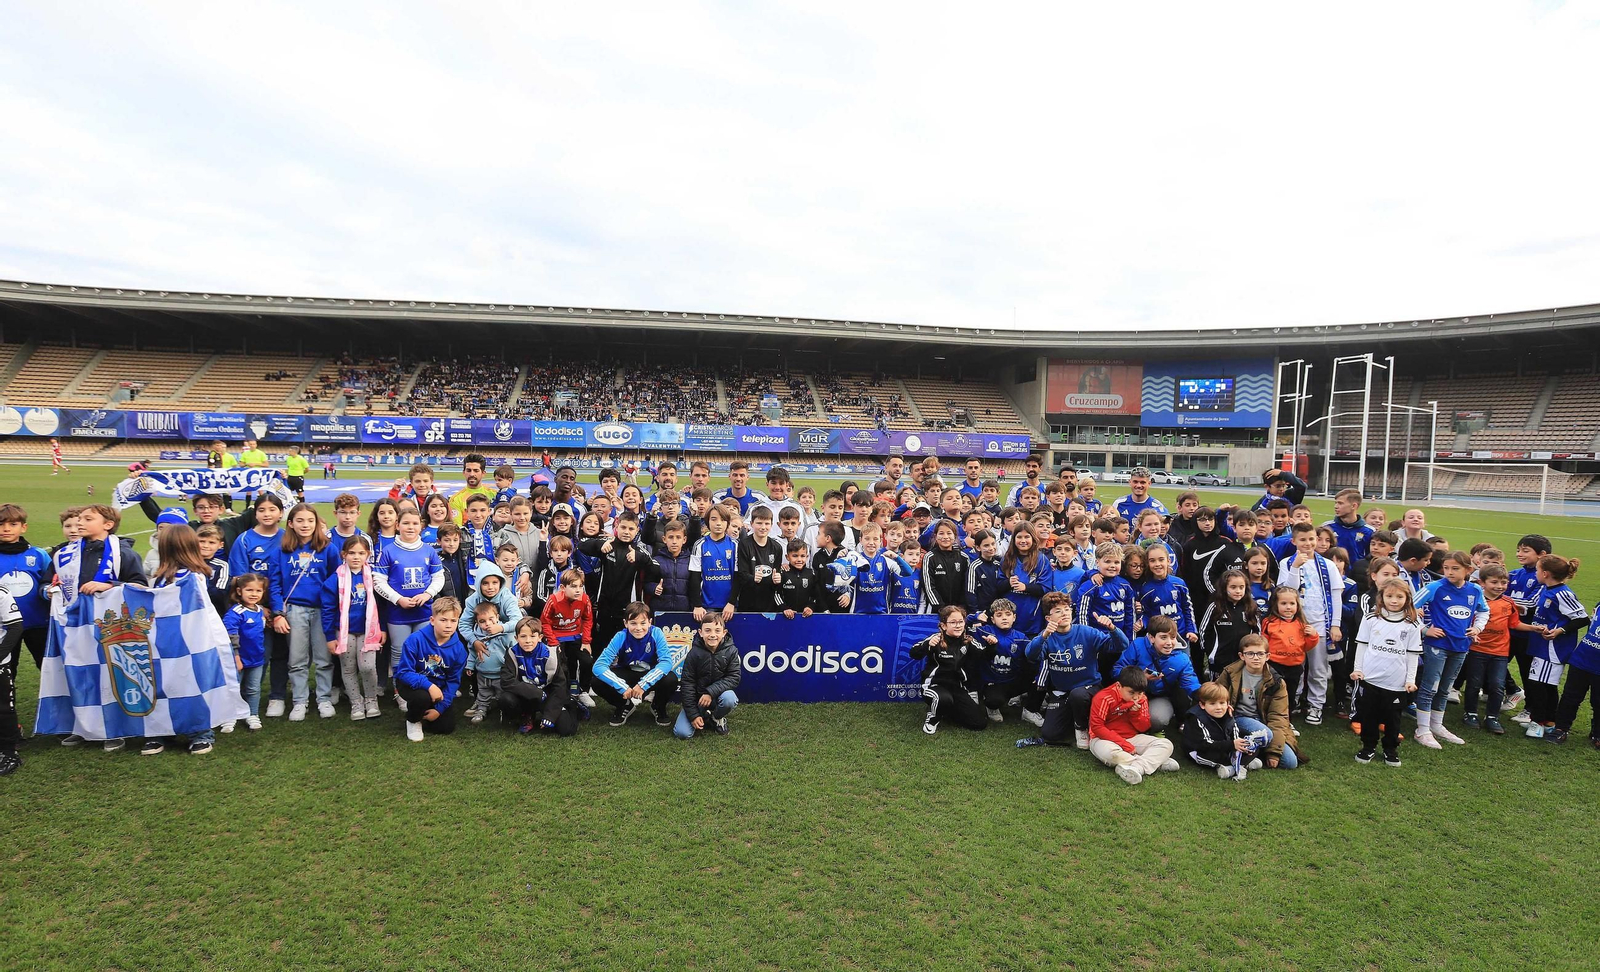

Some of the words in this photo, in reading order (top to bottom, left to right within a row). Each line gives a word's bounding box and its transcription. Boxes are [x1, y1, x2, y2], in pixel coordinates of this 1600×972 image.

[1069, 396, 1119, 407] Cruzcampo
[137, 413, 179, 430] KIRIBATI
[193, 425, 218, 433] Carmen
[310, 424, 356, 434] neopolis.es
[597, 431, 631, 440] LUGO
[742, 434, 784, 446] telepizza
[800, 434, 828, 443] MdR
